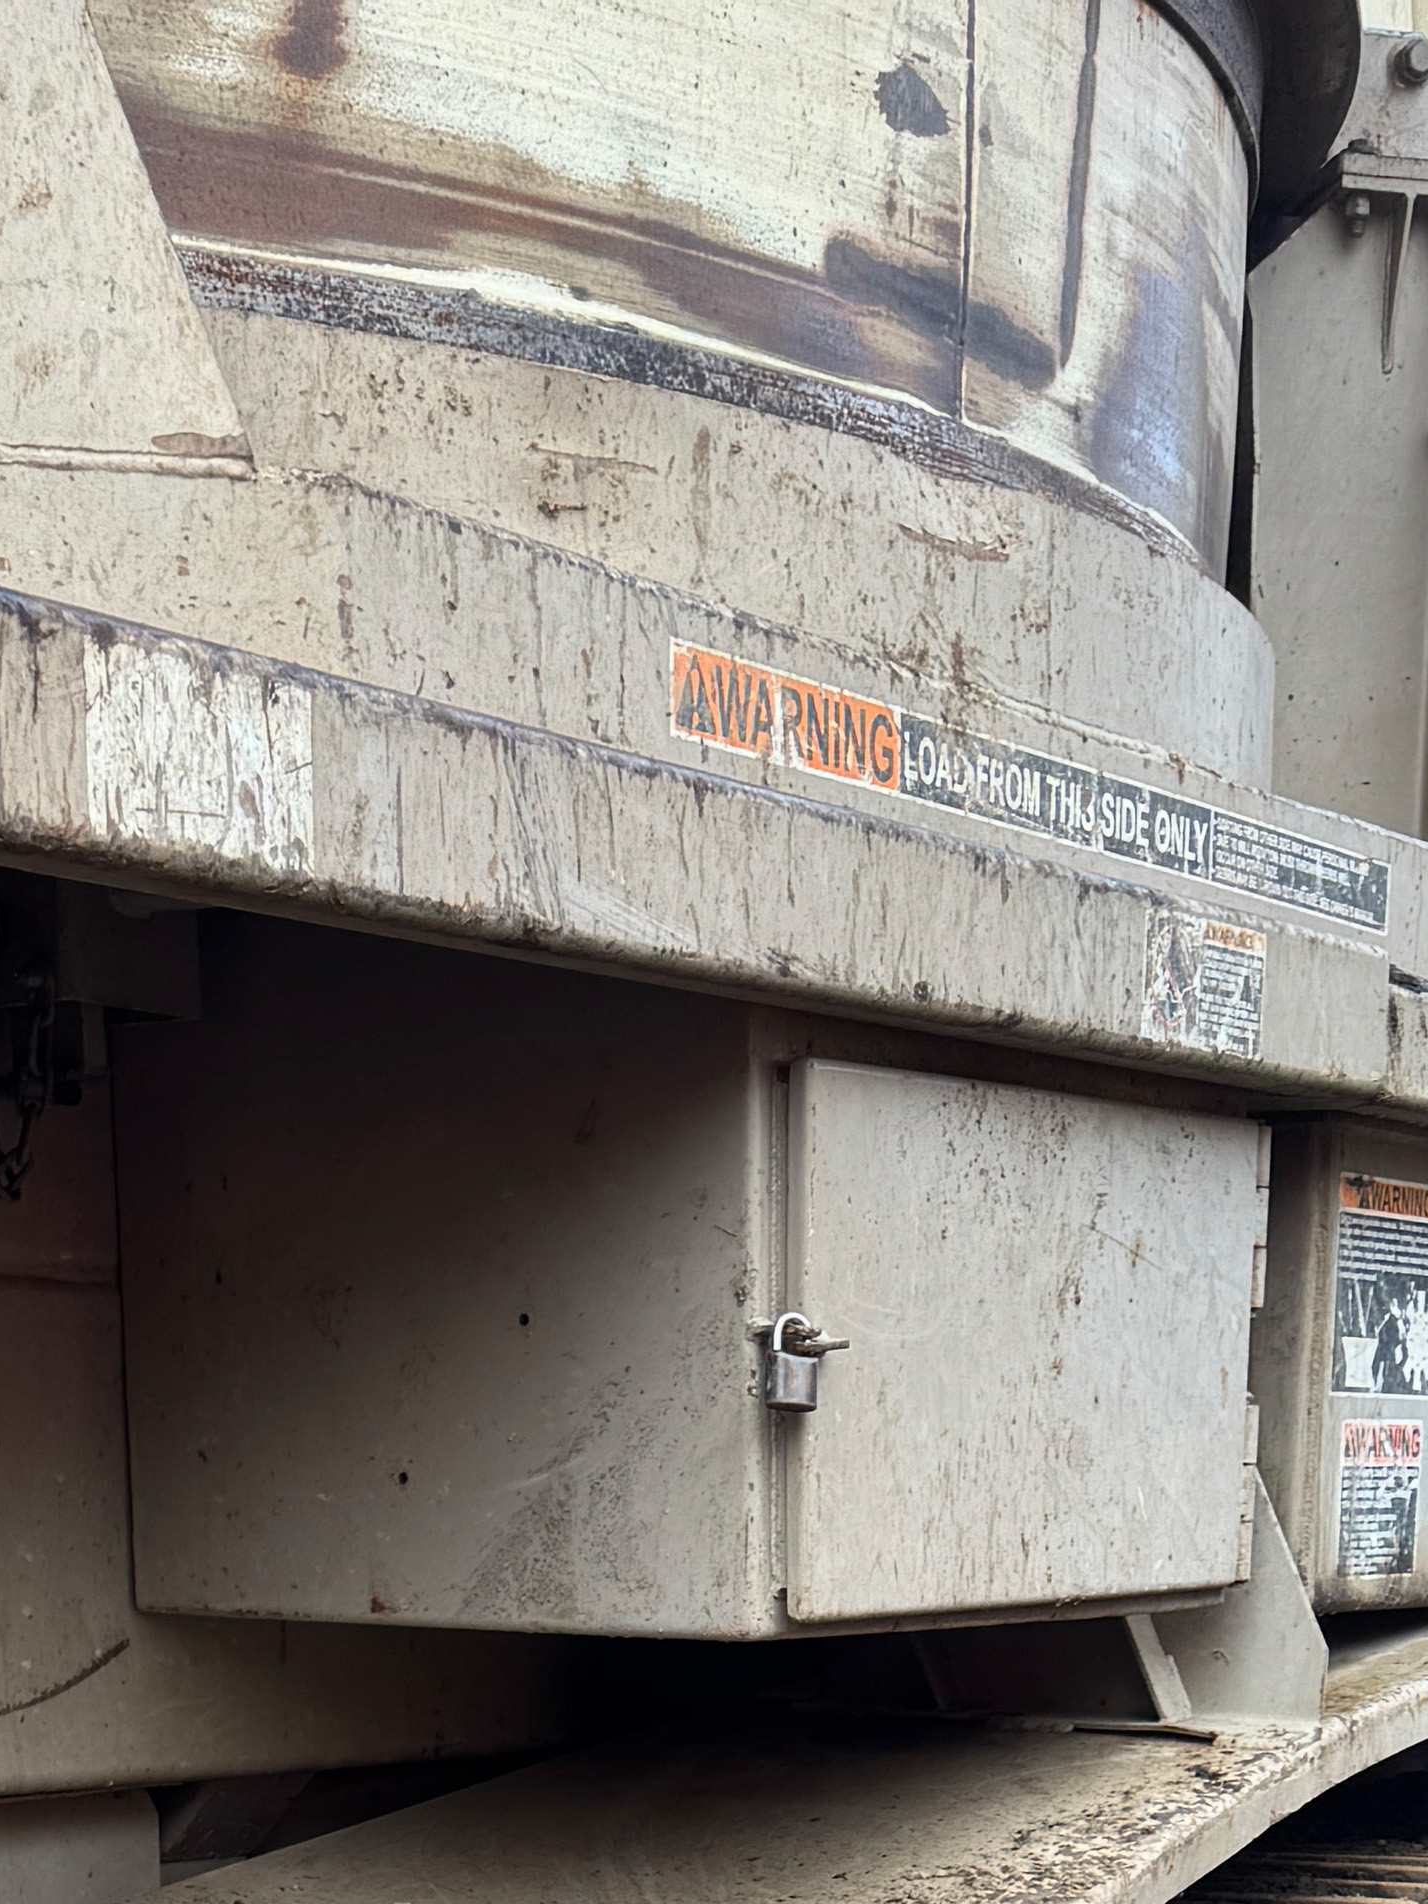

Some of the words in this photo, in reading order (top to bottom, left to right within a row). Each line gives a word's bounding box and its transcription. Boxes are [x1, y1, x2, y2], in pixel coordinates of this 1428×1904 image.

[715, 664, 894, 784] WARNING
[903, 731, 975, 794] LOAD
[976, 753, 1041, 817] FROM
[1046, 775, 1096, 832] THIS
[1101, 792, 1150, 847] SIDE
[1155, 810, 1209, 864] ONLY
[1356, 1425, 1421, 1459] WARNING
